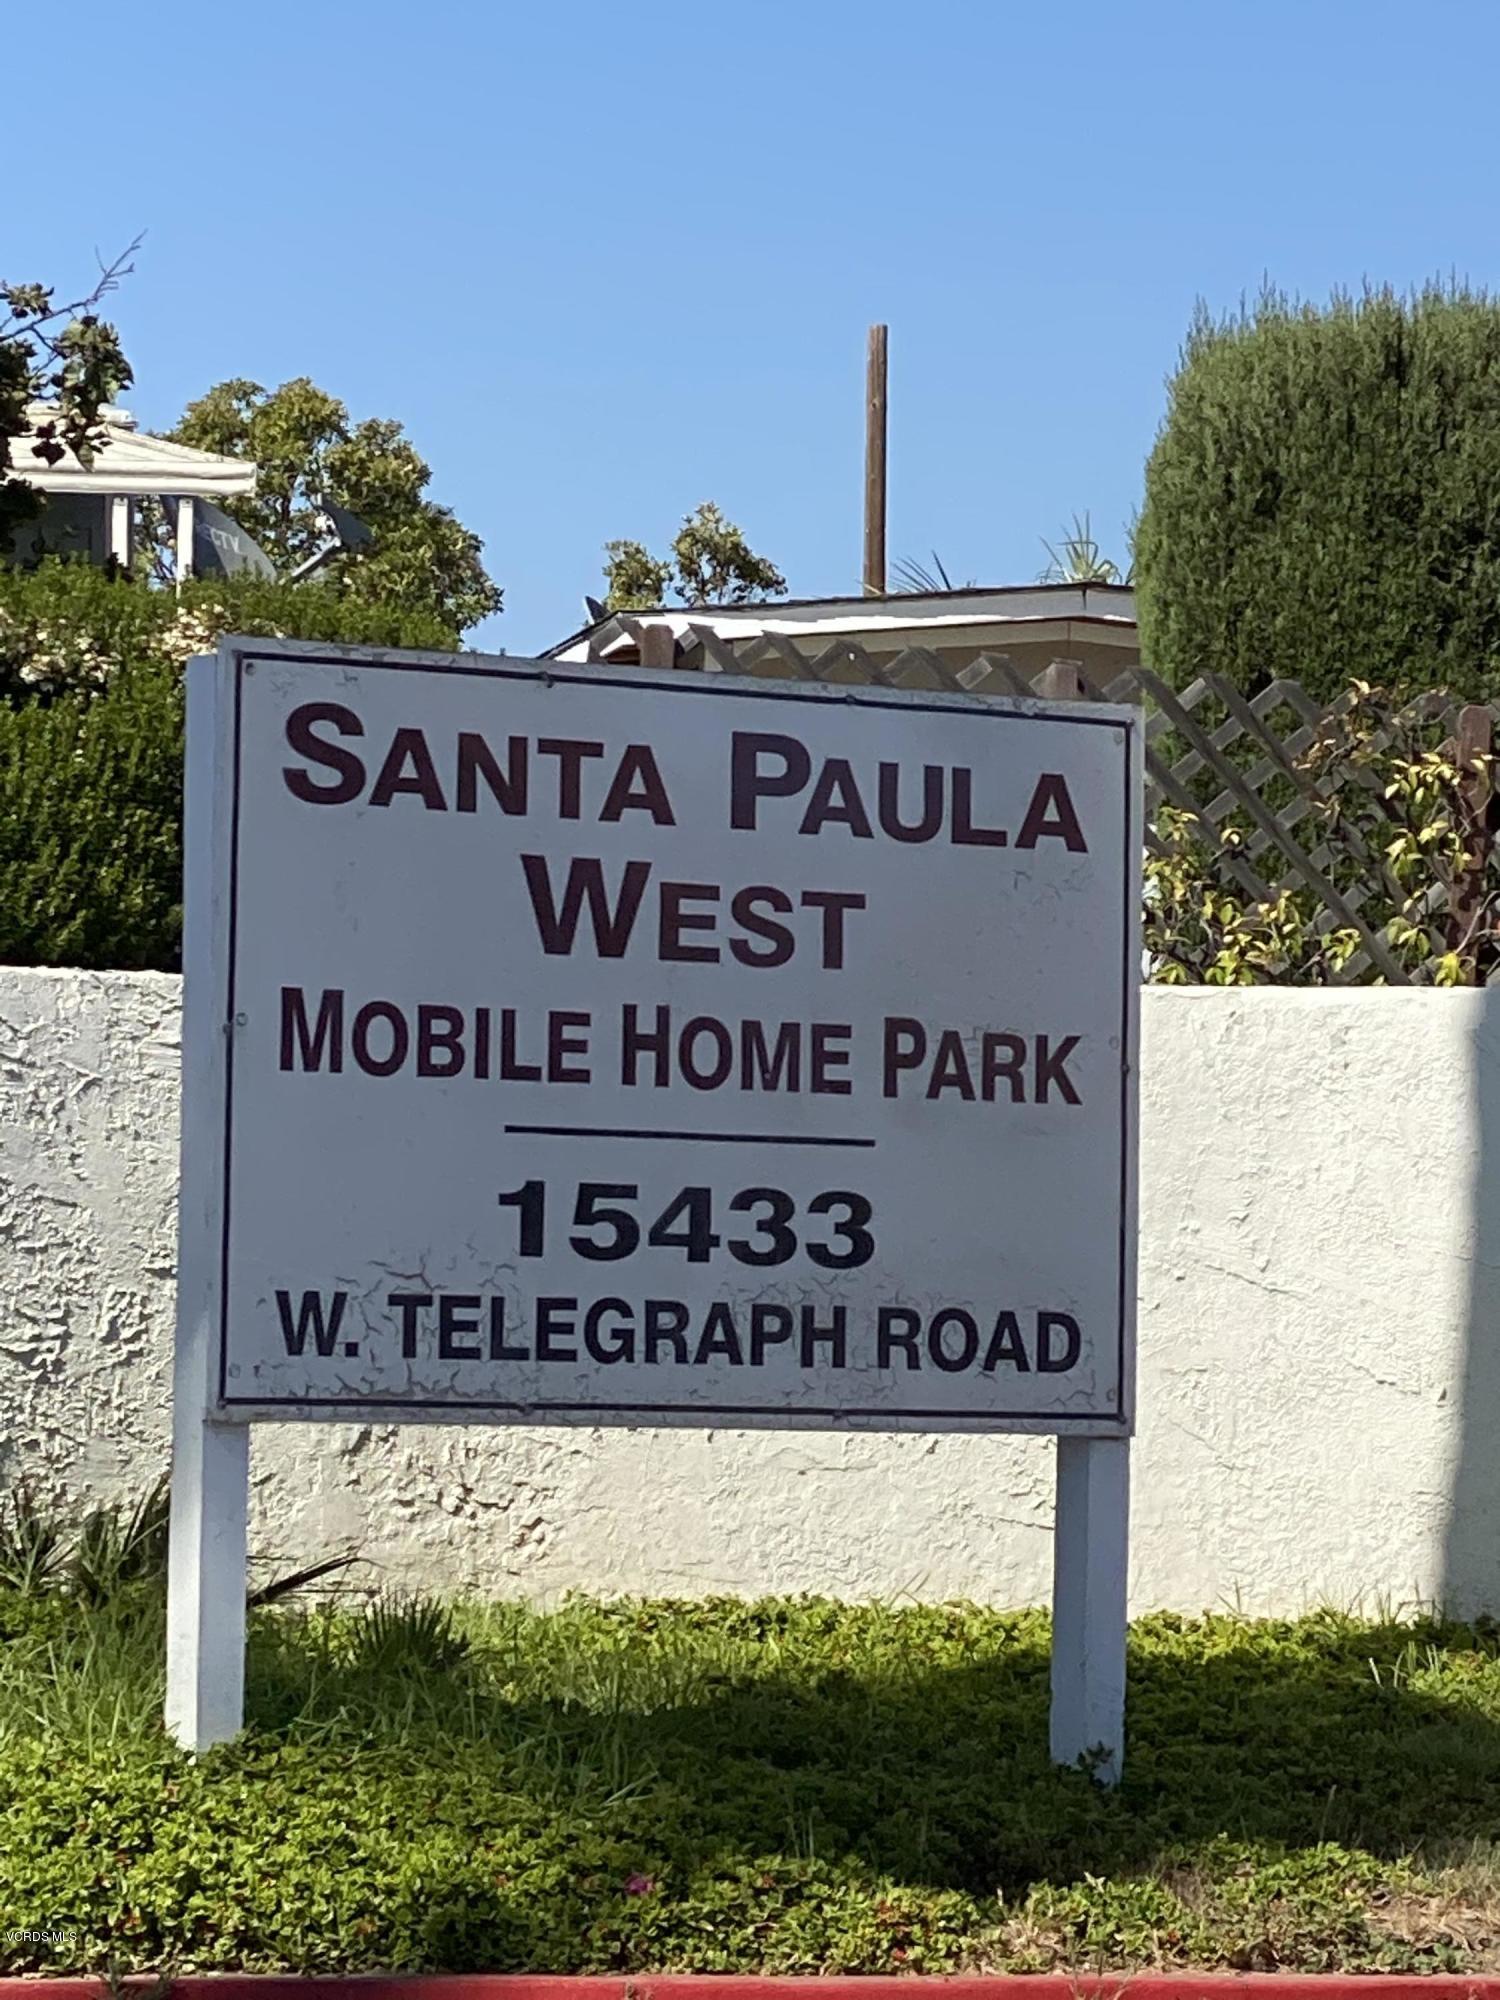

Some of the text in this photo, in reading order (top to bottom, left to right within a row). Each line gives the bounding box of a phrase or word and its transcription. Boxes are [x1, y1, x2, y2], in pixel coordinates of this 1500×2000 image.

[283, 702, 1089, 854] SANTA PAULA
[519, 853, 866, 970] WEST
[279, 986, 1083, 1106] MOBILE HOME PARK
[498, 1179, 876, 1270] 15433
[274, 1289, 1083, 1374] W. TELEGRAPH ROAD
